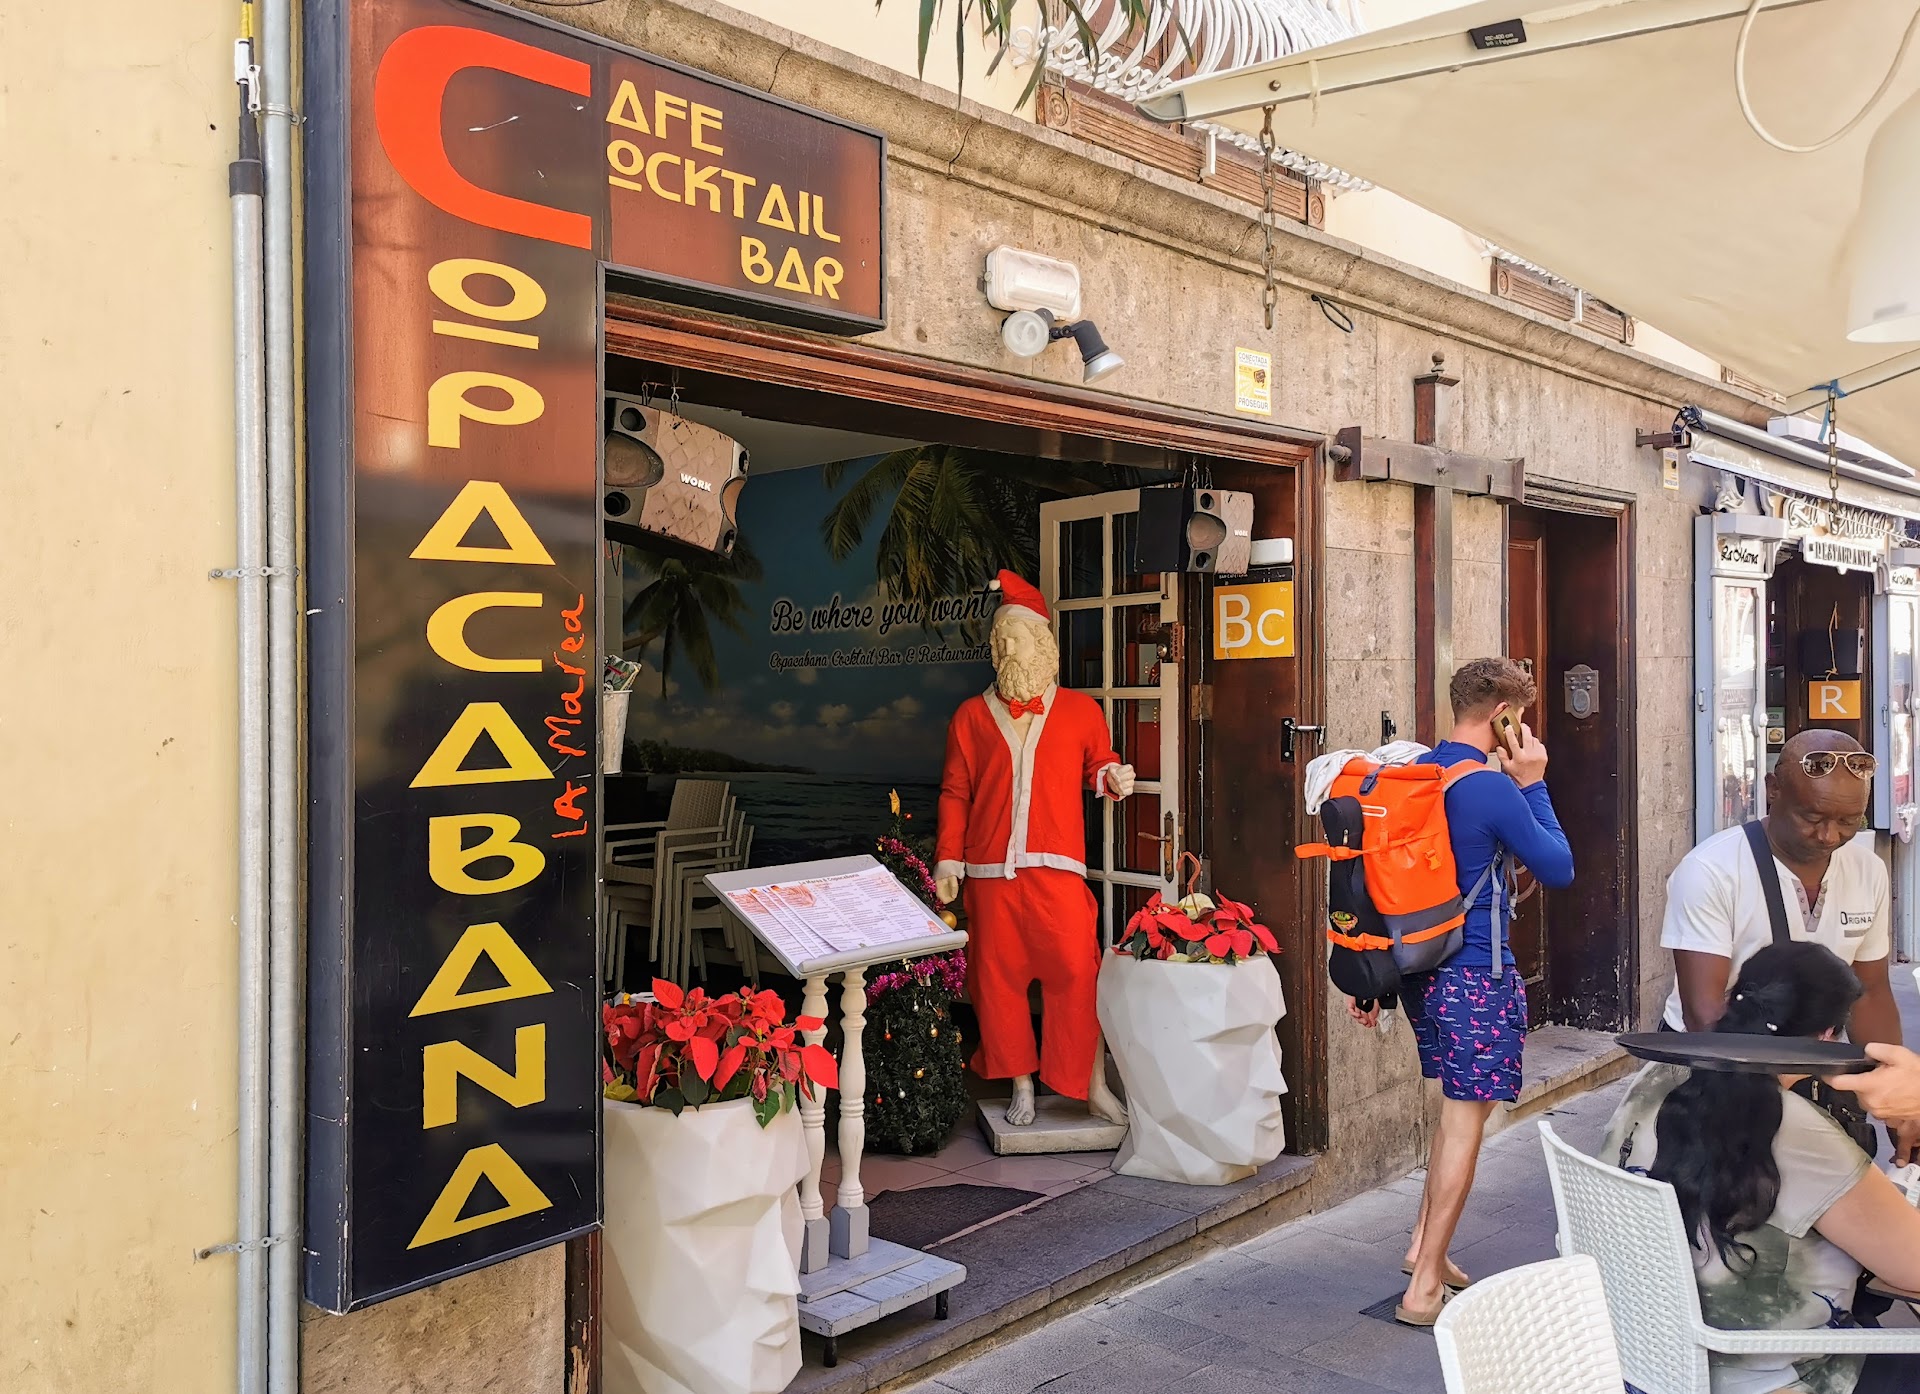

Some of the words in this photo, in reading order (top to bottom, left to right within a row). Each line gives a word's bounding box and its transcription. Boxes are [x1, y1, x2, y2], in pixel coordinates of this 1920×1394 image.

[740, 236, 844, 300] BAR
[1238, 352, 1268, 364] CONECTADA
[1238, 397, 1269, 410] PROSEGUR
[680, 472, 712, 492] WORK
[1234, 529, 1248, 537] WORK
[1814, 541, 1872, 567] RESTAURANTE
[771, 600, 804, 632] Be
[811, 595, 874, 630] where
[879, 601, 924, 635] you
[931, 586, 1004, 623] want
[1219, 594, 1285, 649] Bc
[770, 650, 828, 673] Copacabana
[831, 646, 875, 667] Cocktail
[878, 647, 902, 665] Bar
[905, 649, 914, 663] &
[544, 593, 587, 757] Marea
[1821, 685, 1848, 714] R
